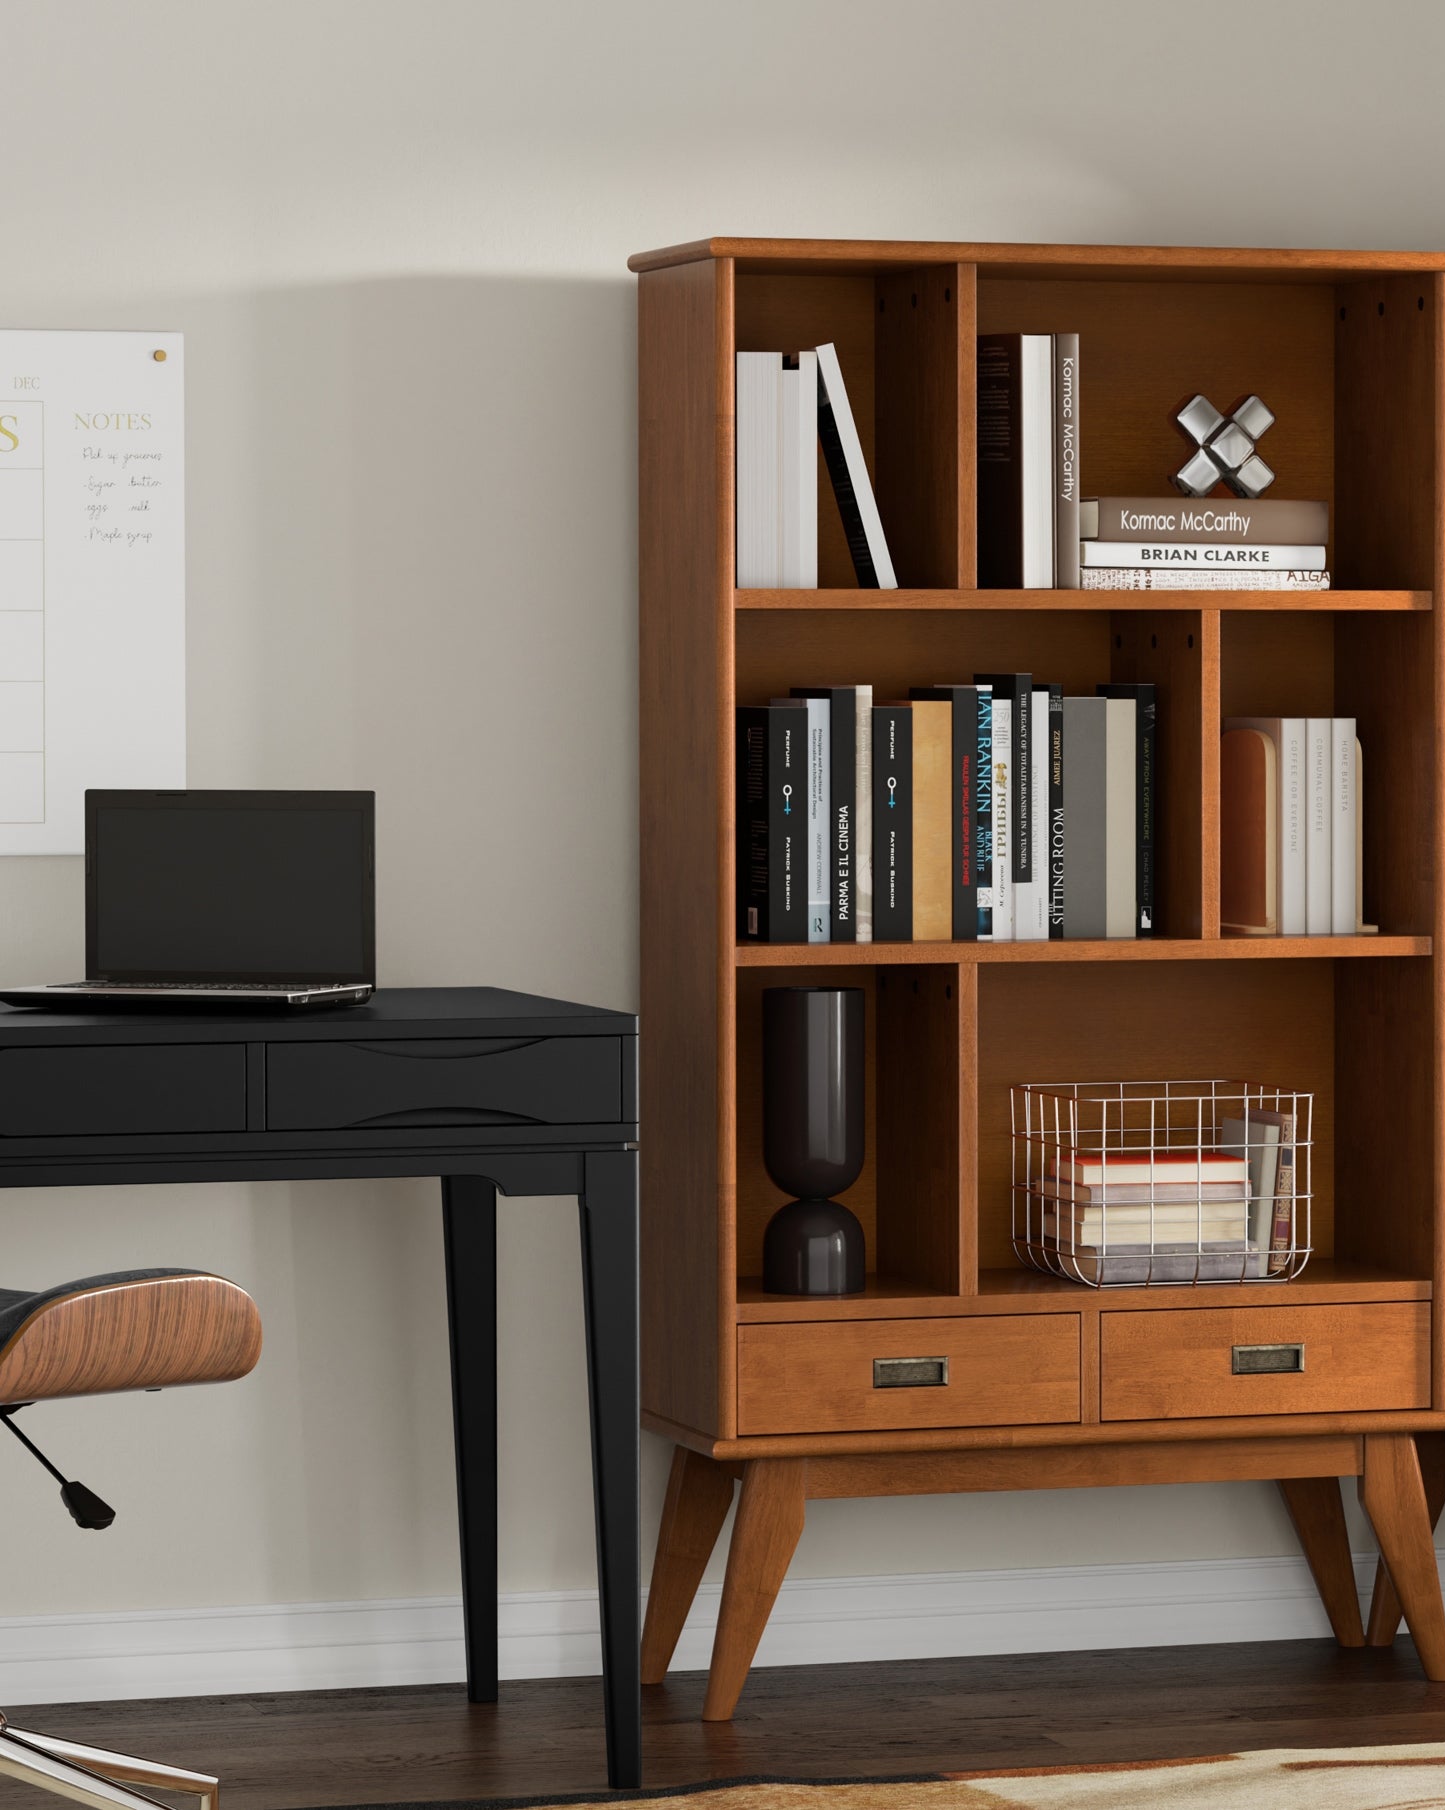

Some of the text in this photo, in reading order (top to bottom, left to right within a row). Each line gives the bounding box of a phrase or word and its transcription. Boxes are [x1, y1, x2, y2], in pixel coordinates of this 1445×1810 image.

[13, 376, 40, 390] DEC
[74, 413, 152, 430] NOTES
[1062, 357, 1074, 501] Kormac McCarthy
[122, 452, 162, 470] groceries
[1120, 510, 1251, 537] Kormac McCarthy
[1140, 548, 1270, 563] BRIAN CLARKE
[1287, 570, 1330, 582] AIGA
[976, 695, 992, 813] IAN RANKIN
[1020, 740, 1027, 750] OF
[1053, 730, 1061, 759] JUAREZ
[839, 806, 848, 851] CINEMA
[996, 792, 1007, 859] ГРИБЫ
[1020, 820, 1027, 829] IN
[984, 831, 992, 862] BLACK
[839, 855, 848, 866] IL
[1053, 807, 1063, 925] SITTING ROOM
[838, 881, 848, 920] PARMA
